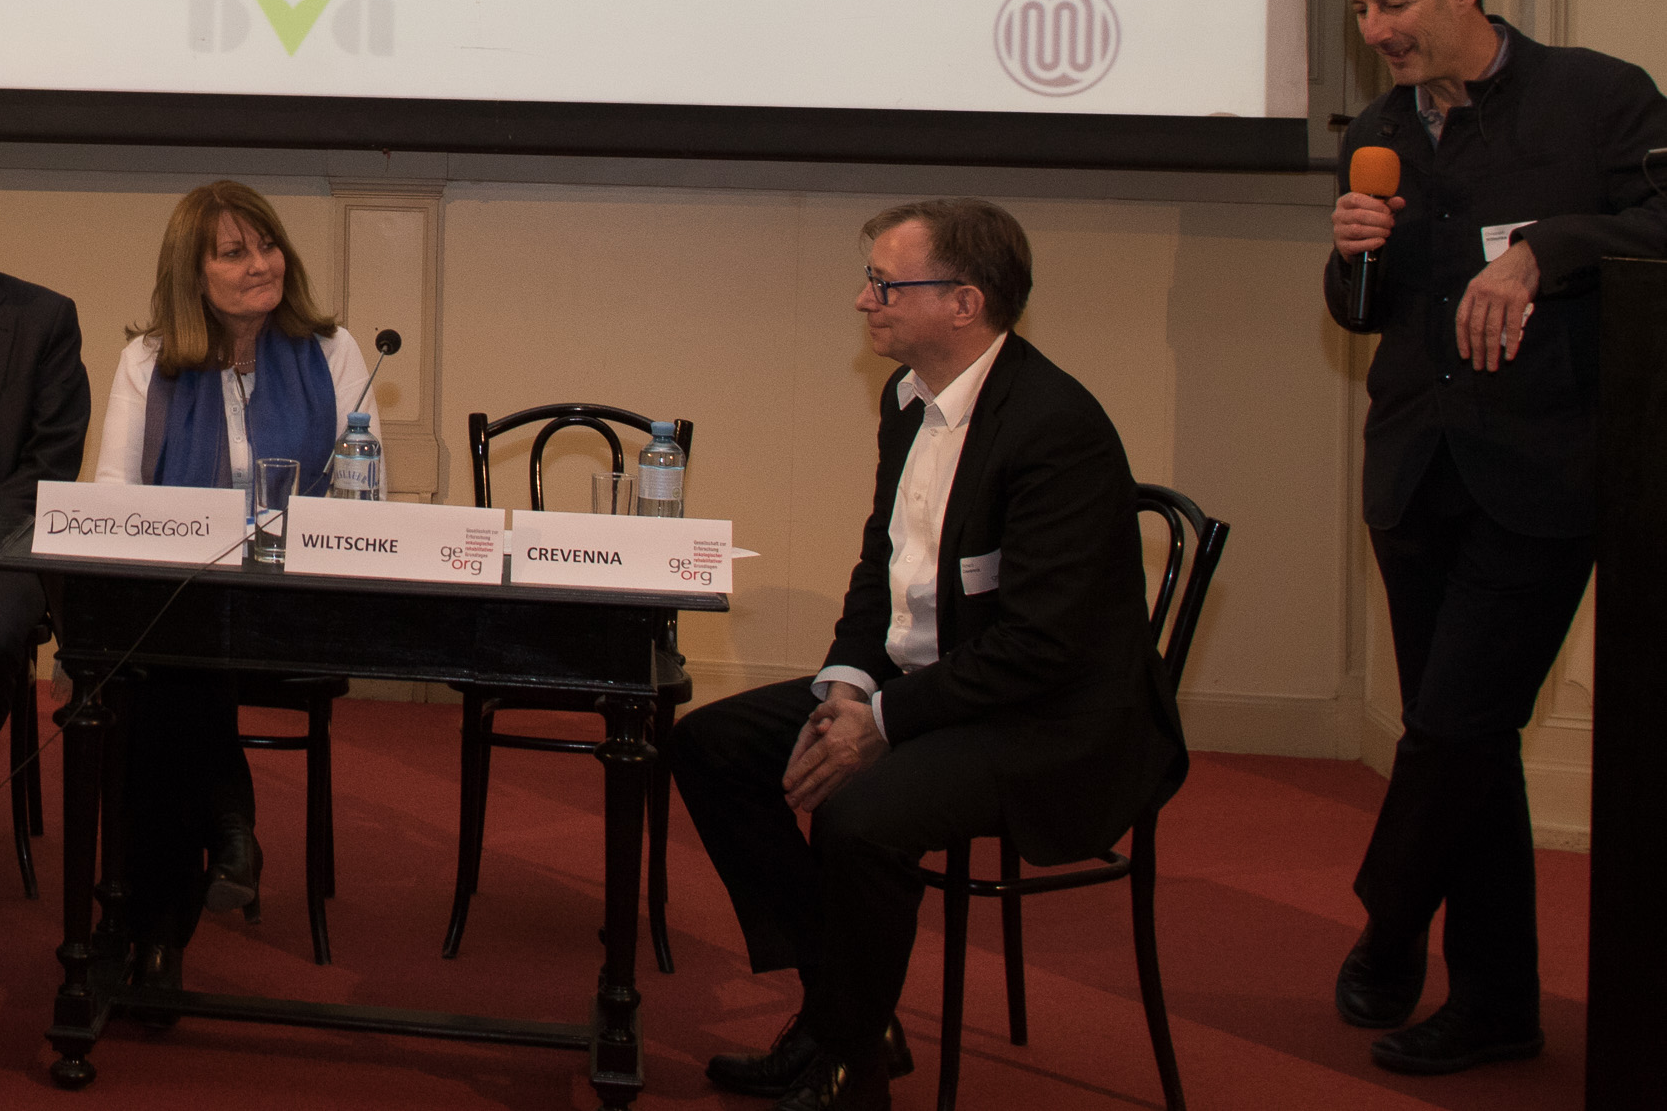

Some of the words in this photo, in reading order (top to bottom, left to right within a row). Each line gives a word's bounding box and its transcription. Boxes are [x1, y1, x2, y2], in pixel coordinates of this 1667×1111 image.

[301, 533, 398, 554] WILTSCHKE
[440, 546, 463, 562] ge
[527, 546, 623, 565] CREVENNA
[451, 558, 482, 575] org
[668, 557, 692, 573] ge
[681, 570, 712, 585] org
